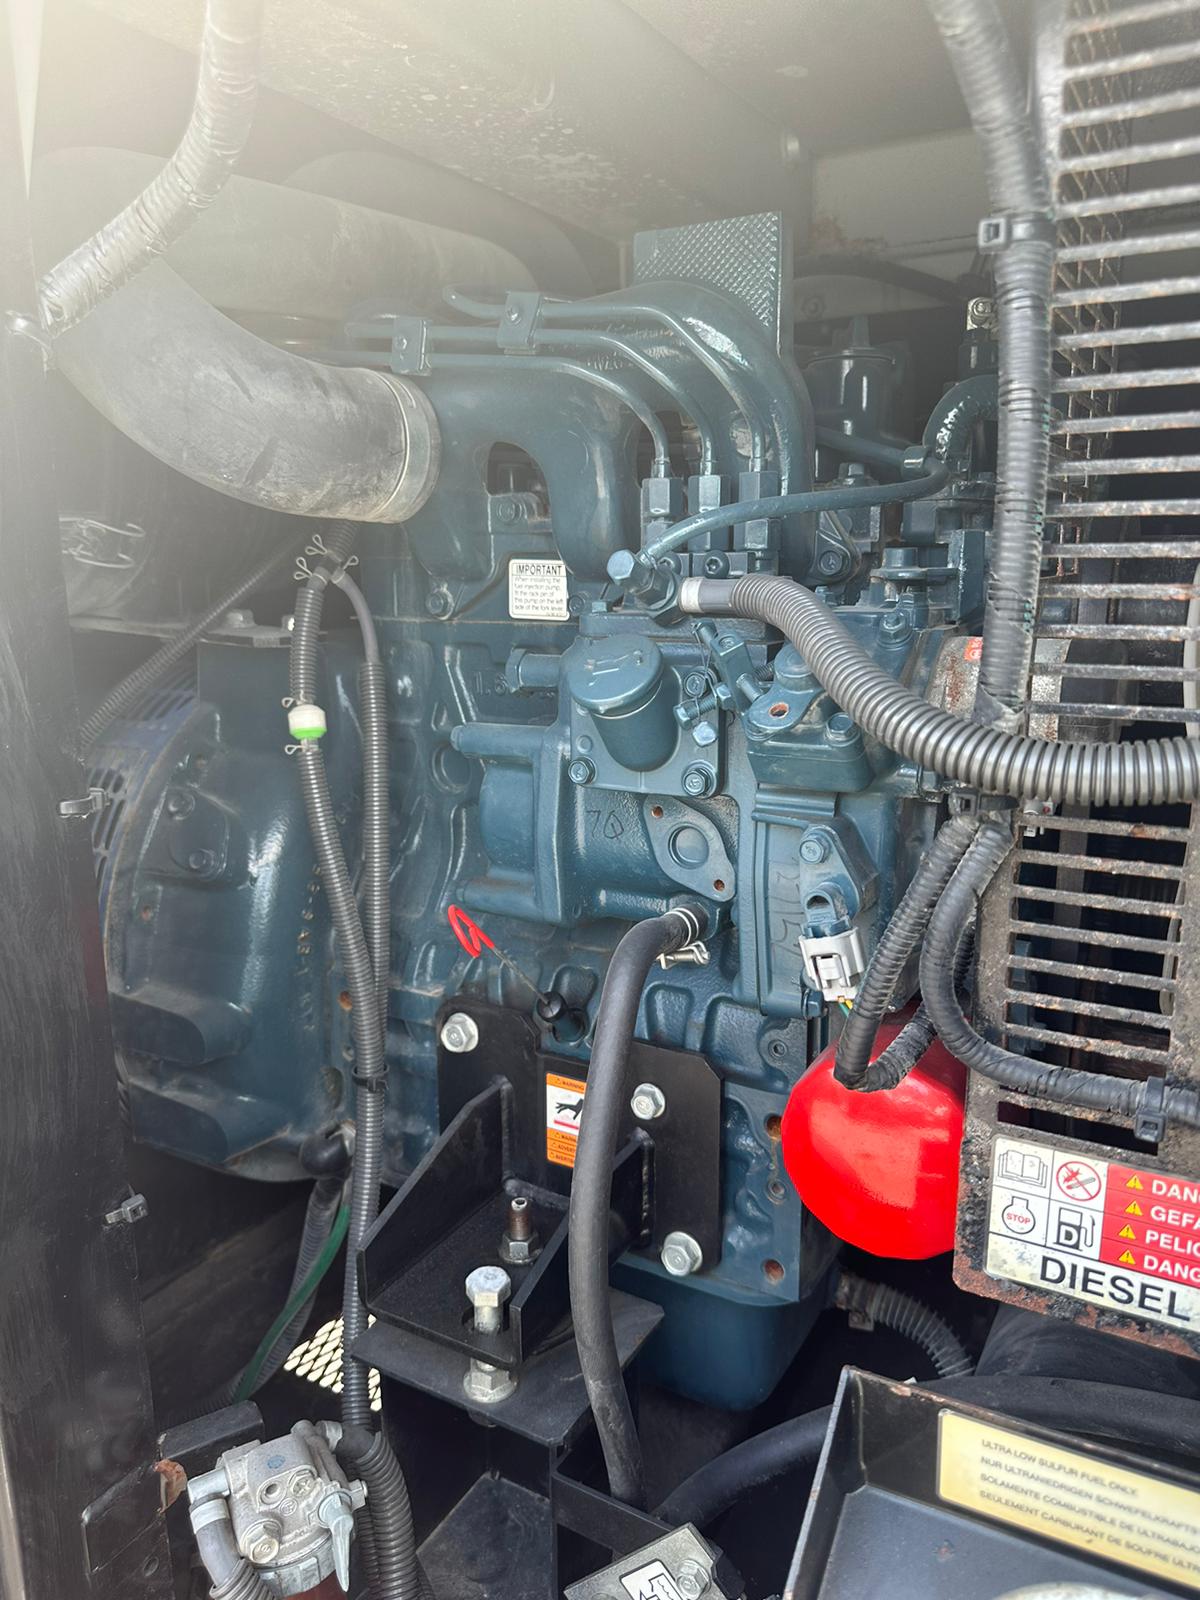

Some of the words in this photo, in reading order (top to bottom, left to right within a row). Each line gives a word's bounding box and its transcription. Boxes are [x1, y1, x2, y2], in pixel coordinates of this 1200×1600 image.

[516, 564, 562, 575] IMPORTANT
[1151, 1179, 1200, 1204] DAN
[1006, 1212, 1031, 1225] STOP
[1143, 1254, 1200, 1283] DANG
[1040, 1255, 1190, 1322] DIESEL
[980, 1455, 1003, 1470] NUR
[981, 1438, 1012, 1456] ULTRA
[1013, 1449, 1037, 1463] LOW
[1038, 1457, 1079, 1478] SULFUR
[1080, 1471, 1107, 1488] FUEL
[980, 1472, 1041, 1501] SOLAMENTE
[1042, 1494, 1117, 1527] COMBUSTIBLE
[1118, 1520, 1135, 1532] DE
[979, 1489, 1040, 1517] SEULEMENT
[1040, 1511, 1105, 1540] CARBURANT
[1106, 1533, 1122, 1547] DE
